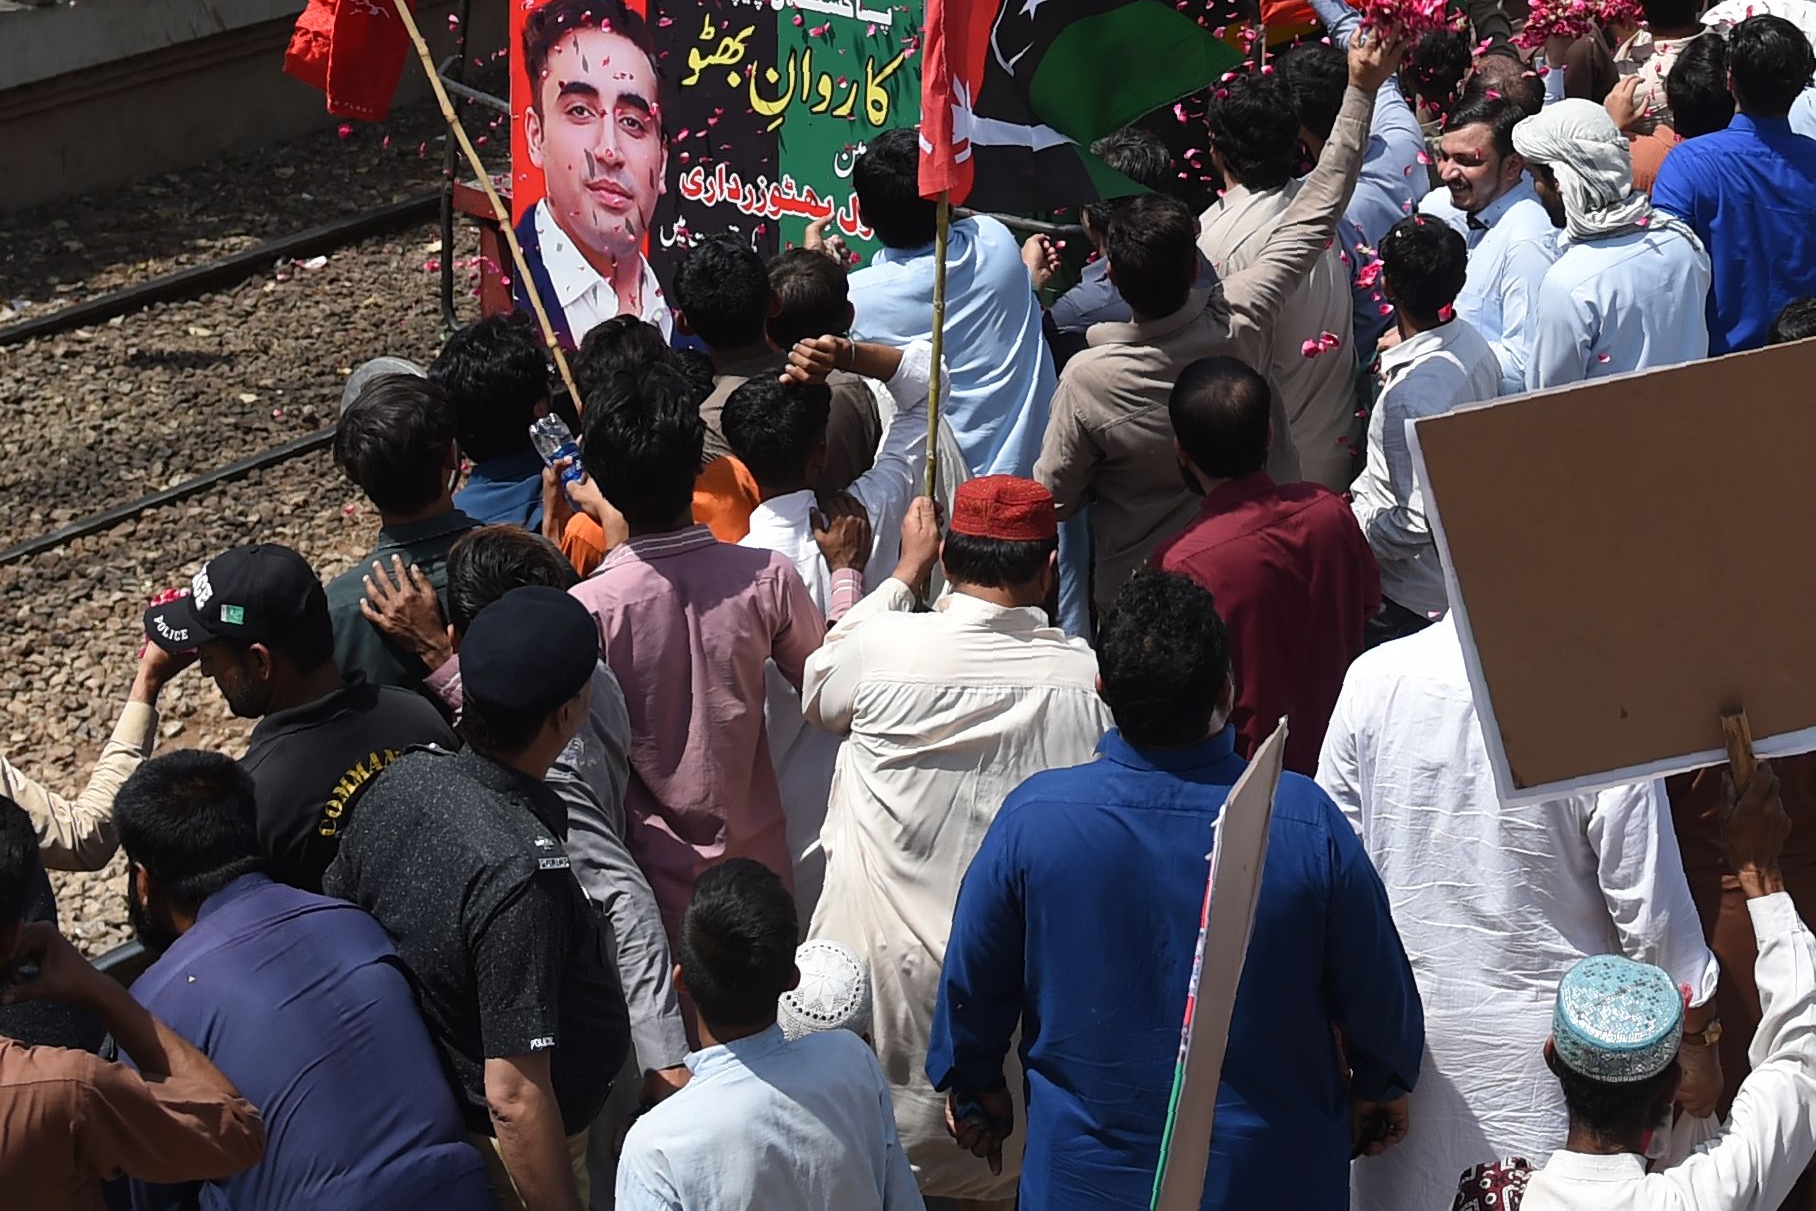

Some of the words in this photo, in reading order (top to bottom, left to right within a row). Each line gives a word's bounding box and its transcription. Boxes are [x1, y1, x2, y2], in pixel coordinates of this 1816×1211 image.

[680, 12, 756, 88] بھٹو
[153, 614, 190, 642] POLICE
[319, 749, 401, 836] COMMAN
